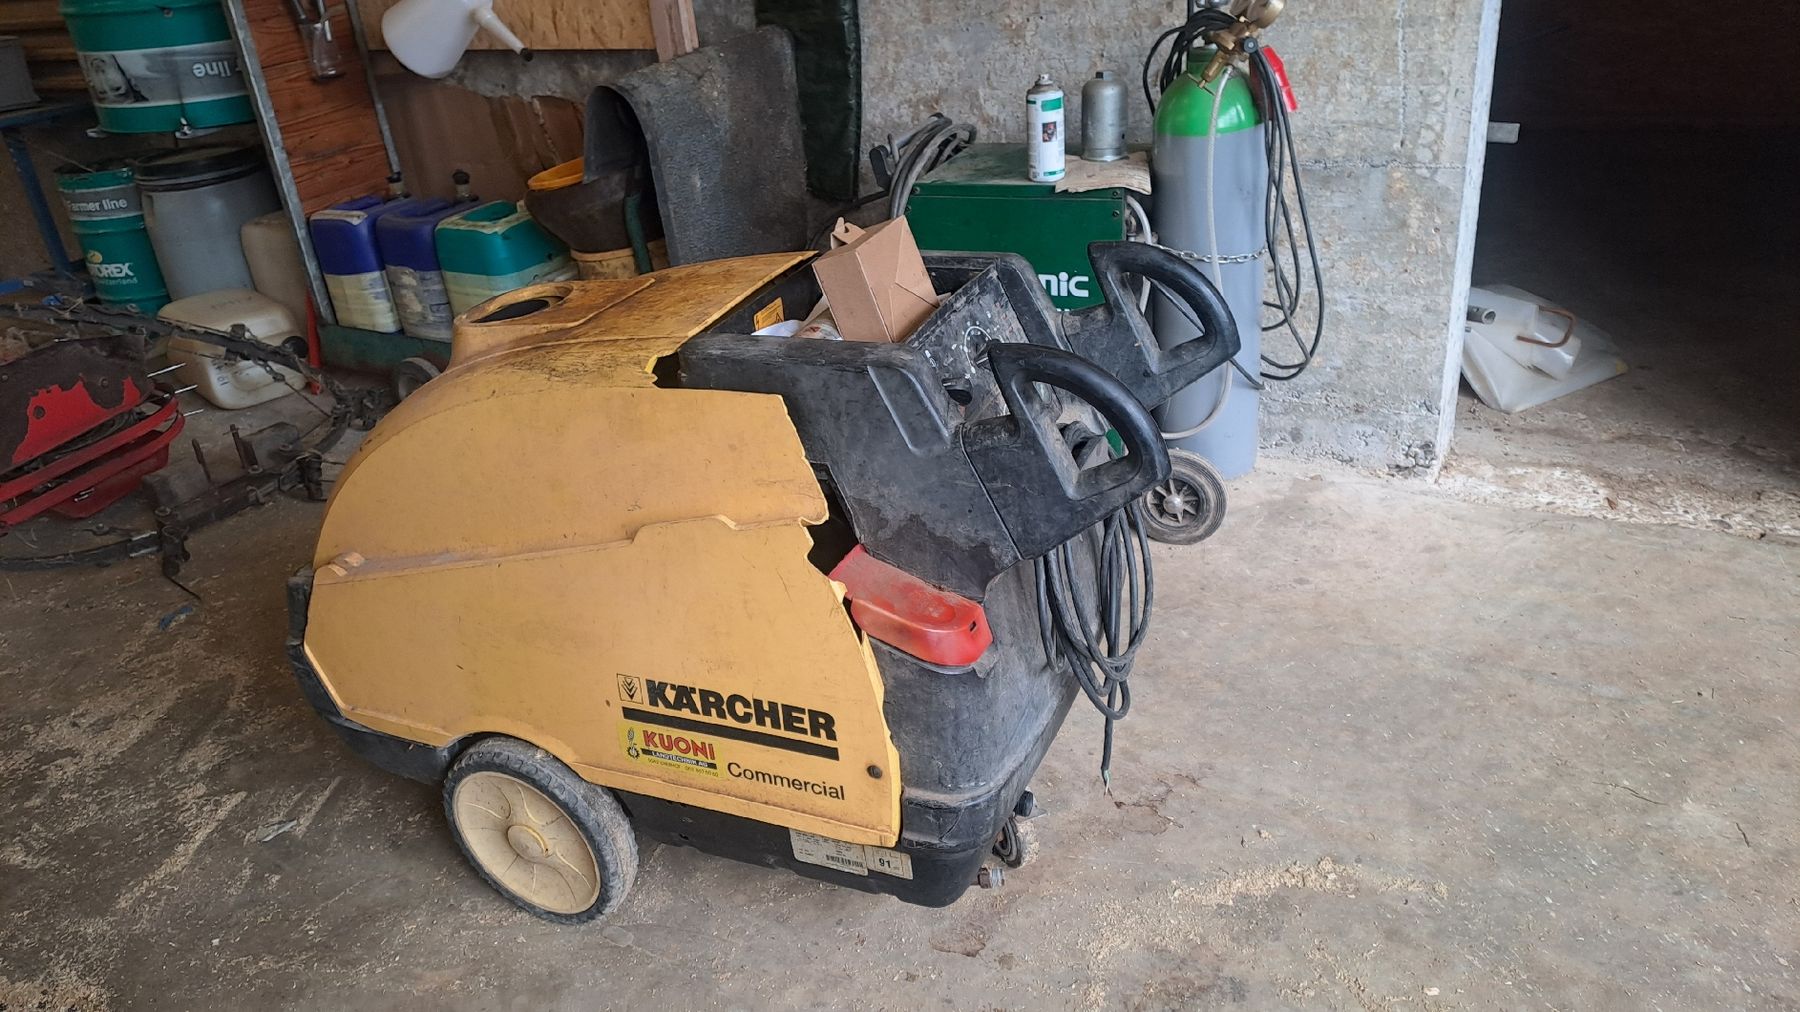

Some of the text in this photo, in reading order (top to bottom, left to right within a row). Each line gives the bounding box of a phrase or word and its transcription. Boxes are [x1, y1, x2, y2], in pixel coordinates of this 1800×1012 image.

[192, 60, 231, 77] line
[102, 198, 128, 211] line
[645, 678, 838, 742] KÄRCHER
[642, 729, 716, 761] KUONI
[727, 761, 845, 801] Commercial
